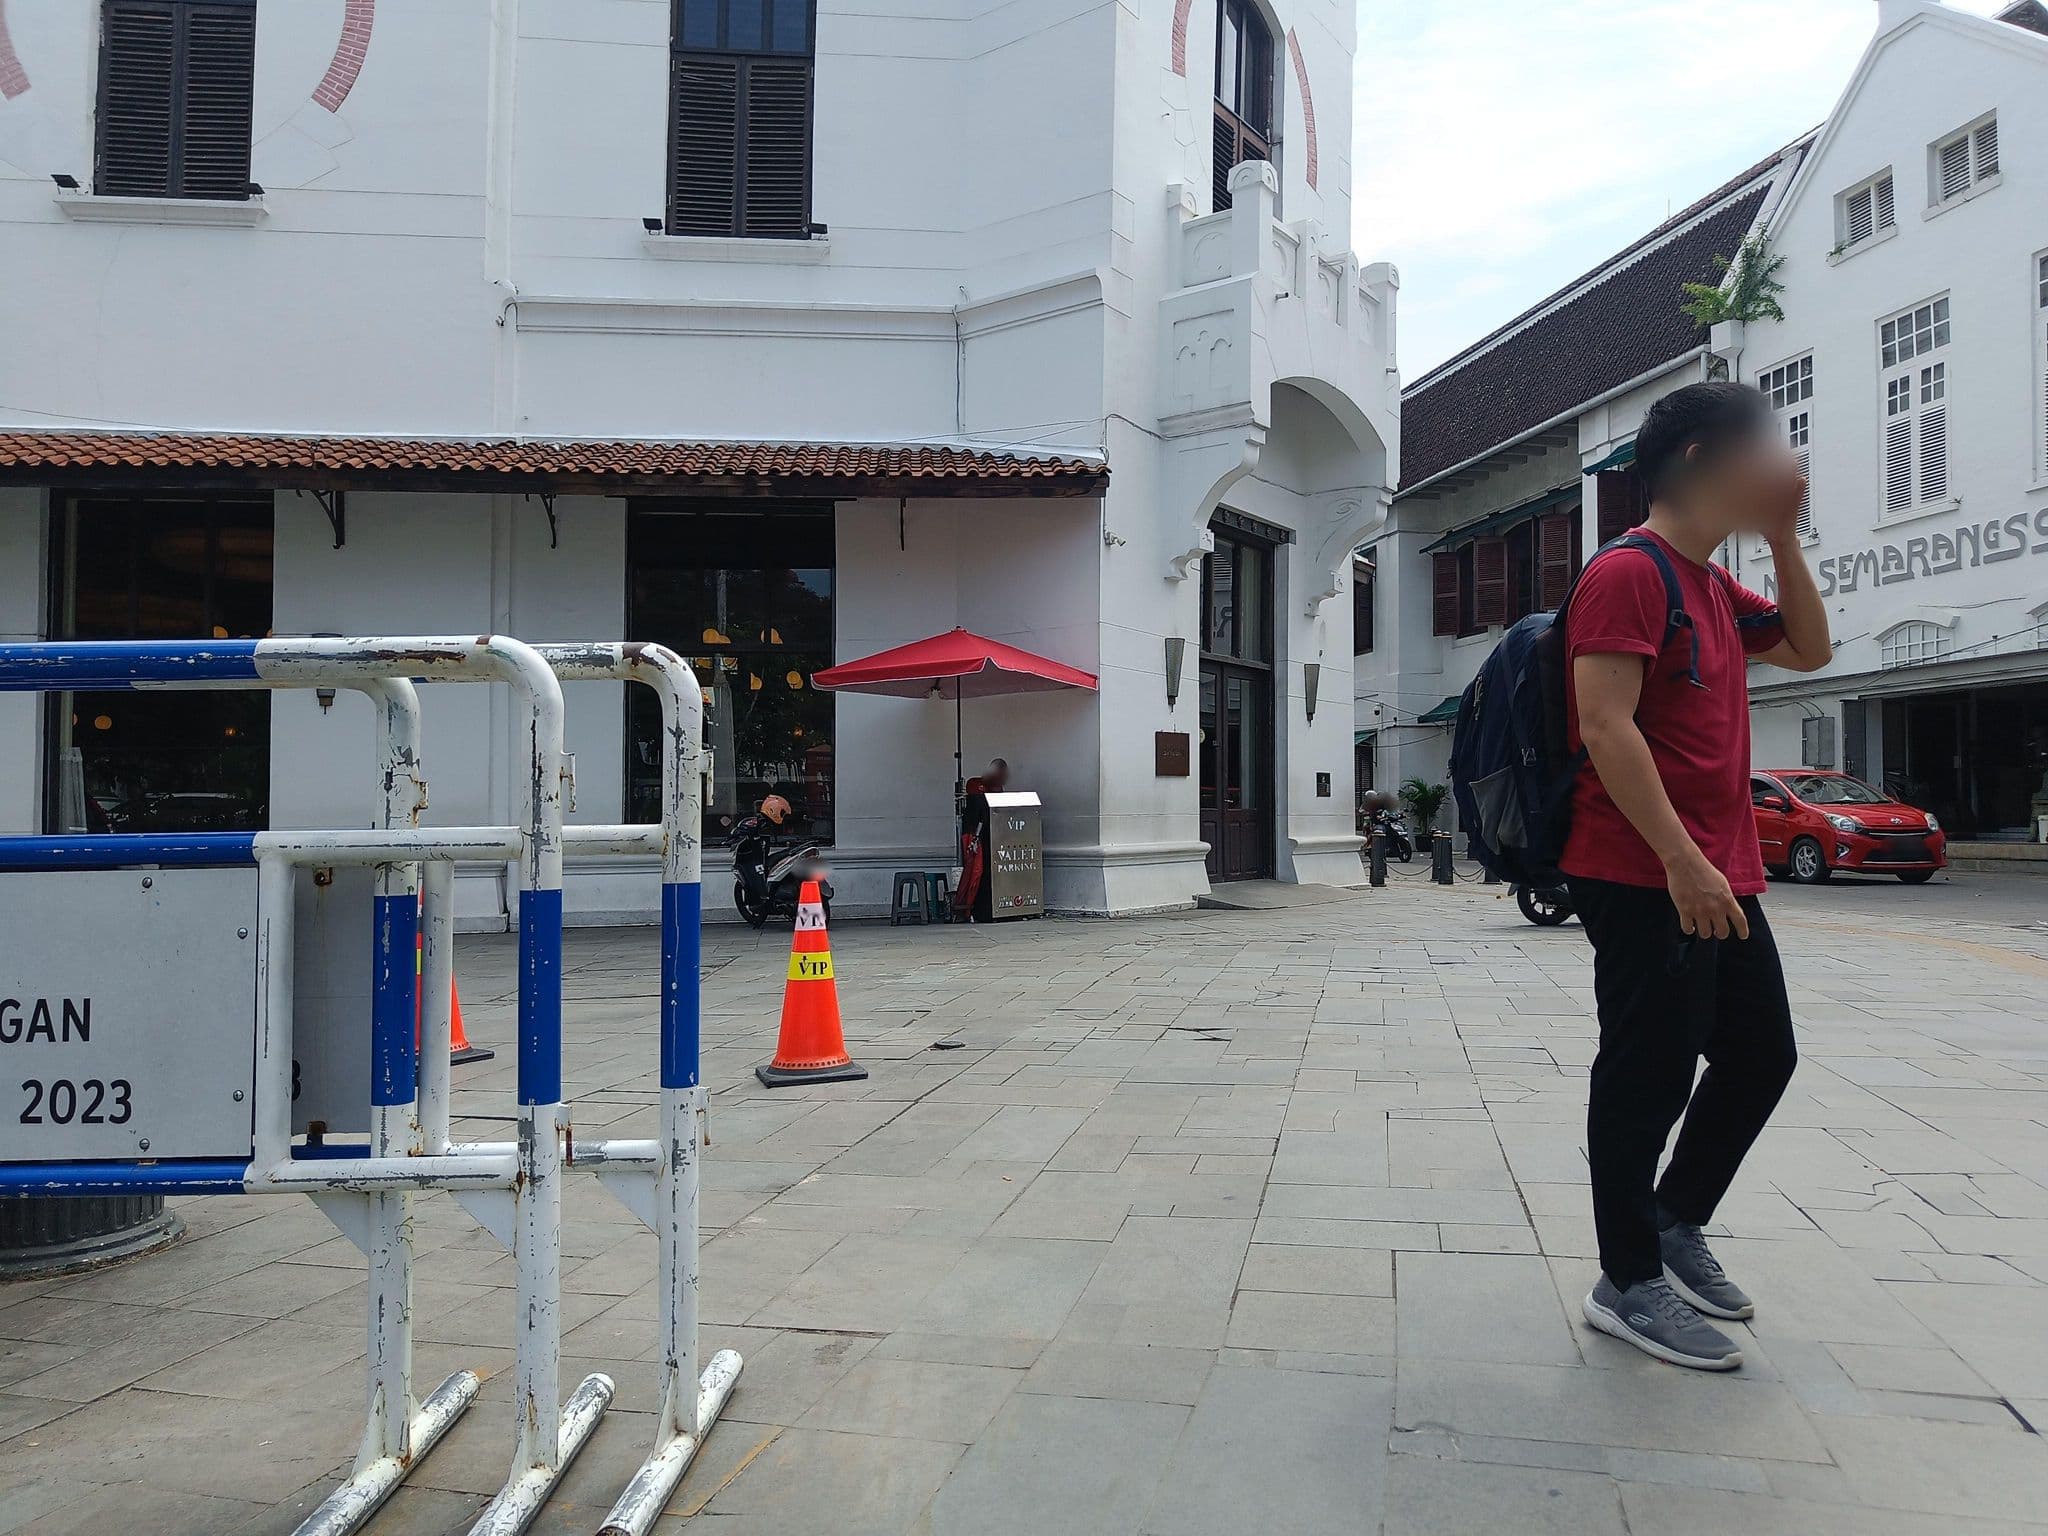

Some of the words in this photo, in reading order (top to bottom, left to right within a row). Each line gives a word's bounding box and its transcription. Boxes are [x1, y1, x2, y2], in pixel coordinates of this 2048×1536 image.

[1007, 818, 1025, 830] VIP
[997, 847, 1037, 861] VALET
[997, 863, 1037, 873] PARKING
[799, 959, 828, 976] VIP
[0, 998, 91, 1043] GAN
[20, 1079, 132, 1124] 2023
